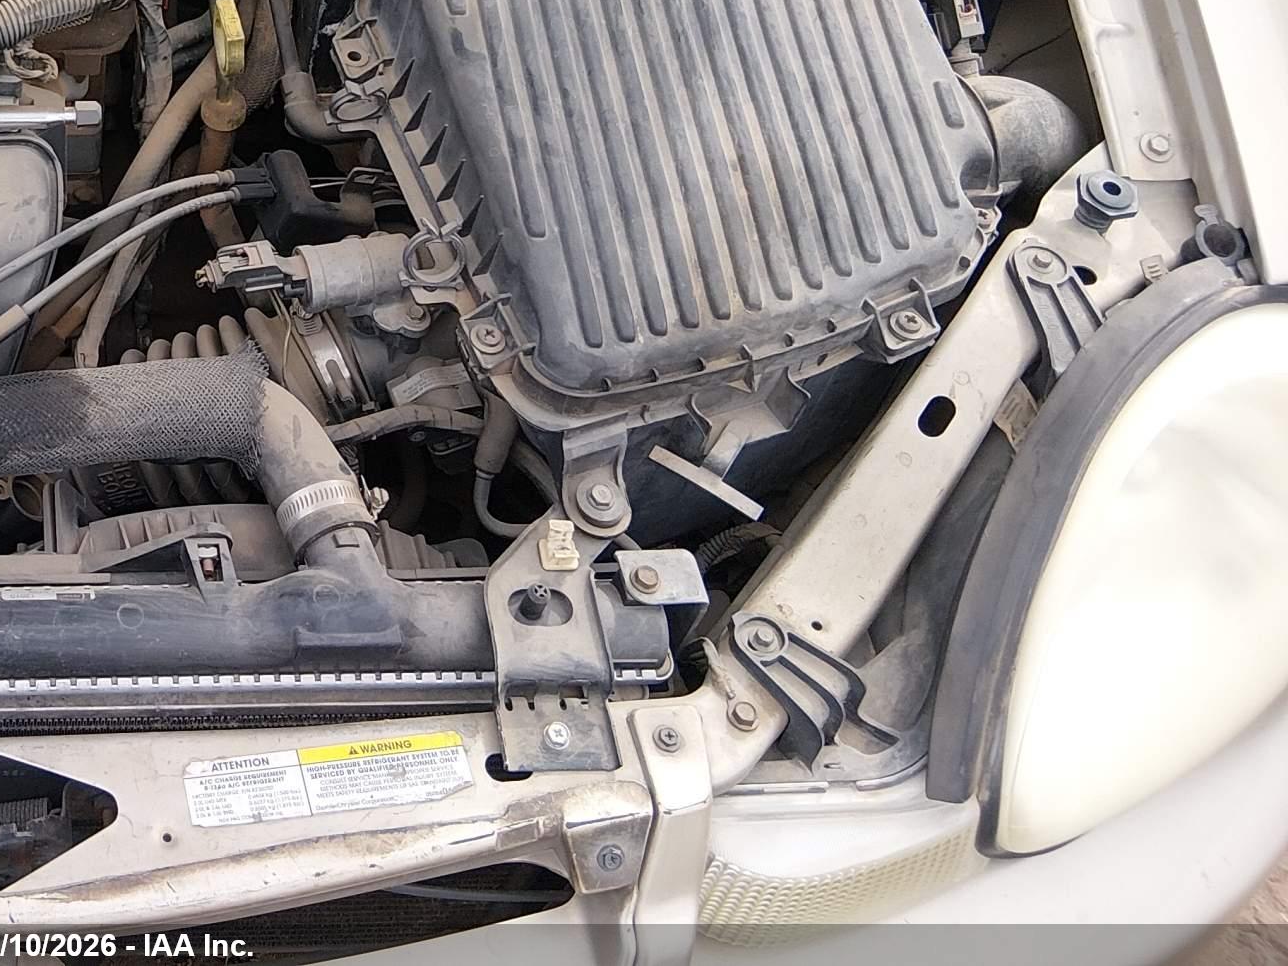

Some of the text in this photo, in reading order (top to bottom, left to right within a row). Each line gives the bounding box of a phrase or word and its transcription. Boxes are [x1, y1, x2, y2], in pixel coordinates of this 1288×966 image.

[359, 740, 412, 754] WARNING
[212, 757, 270, 772] ATTENTION
[306, 761, 361, 773] HIGH-PRESSURE
[363, 756, 410, 767] REFRIGERANT
[412, 751, 439, 761] SYSTEM
[244, 770, 287, 780] REQUIREMENT
[311, 770, 345, 780] SERVICED
[358, 765, 394, 774] QUALIFIED
[242, 777, 285, 786] REFRIGERANT
